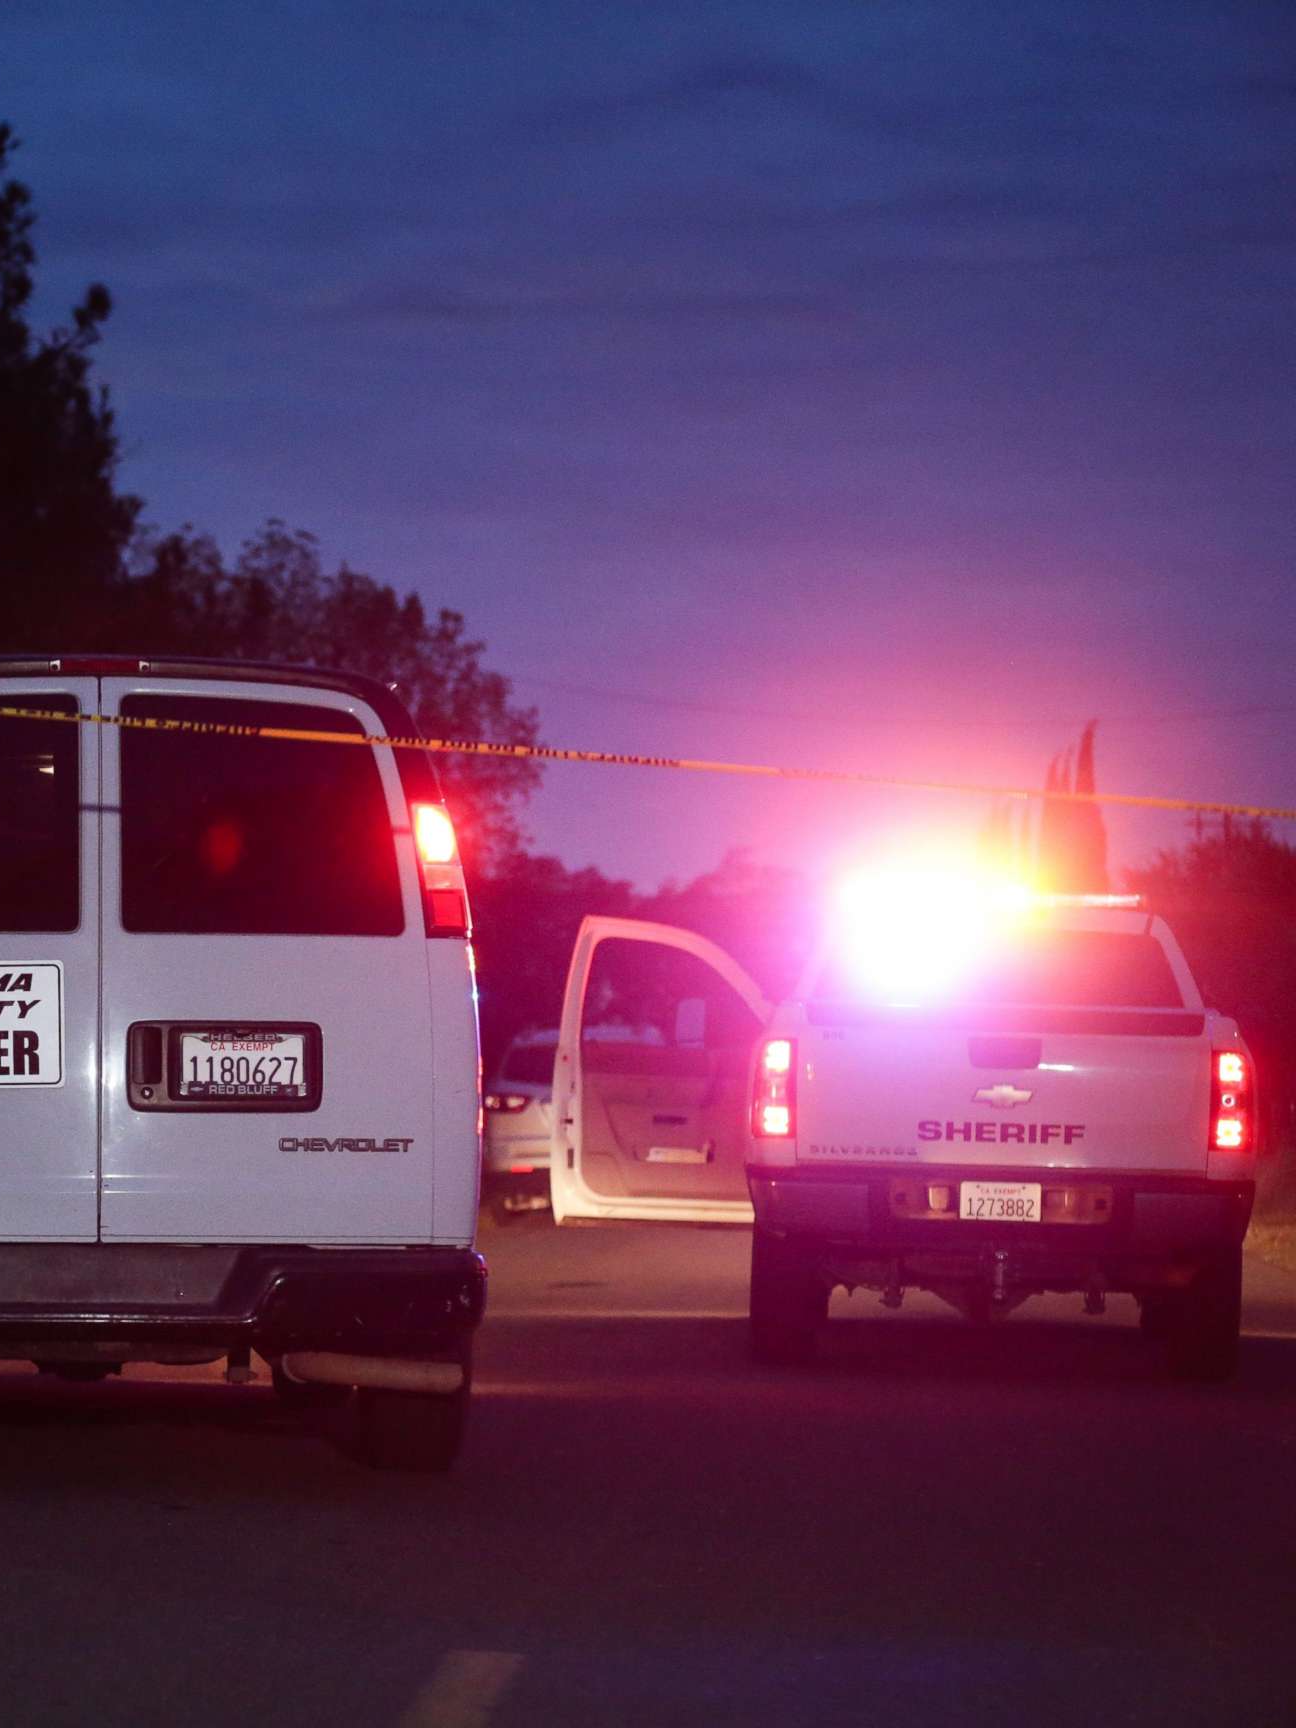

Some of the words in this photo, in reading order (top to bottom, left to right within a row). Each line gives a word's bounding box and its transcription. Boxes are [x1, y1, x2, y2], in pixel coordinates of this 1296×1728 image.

[210, 1042, 226, 1051] CA
[232, 1042, 275, 1051] EXEMPT
[189, 1056, 298, 1085] 1180627
[208, 1085, 235, 1095] RED
[237, 1085, 278, 1095] BLUFF
[917, 1120, 1086, 1145] SHERIFF
[278, 1137, 415, 1152] CHEVROLET
[966, 1197, 1035, 1218] 1273882
